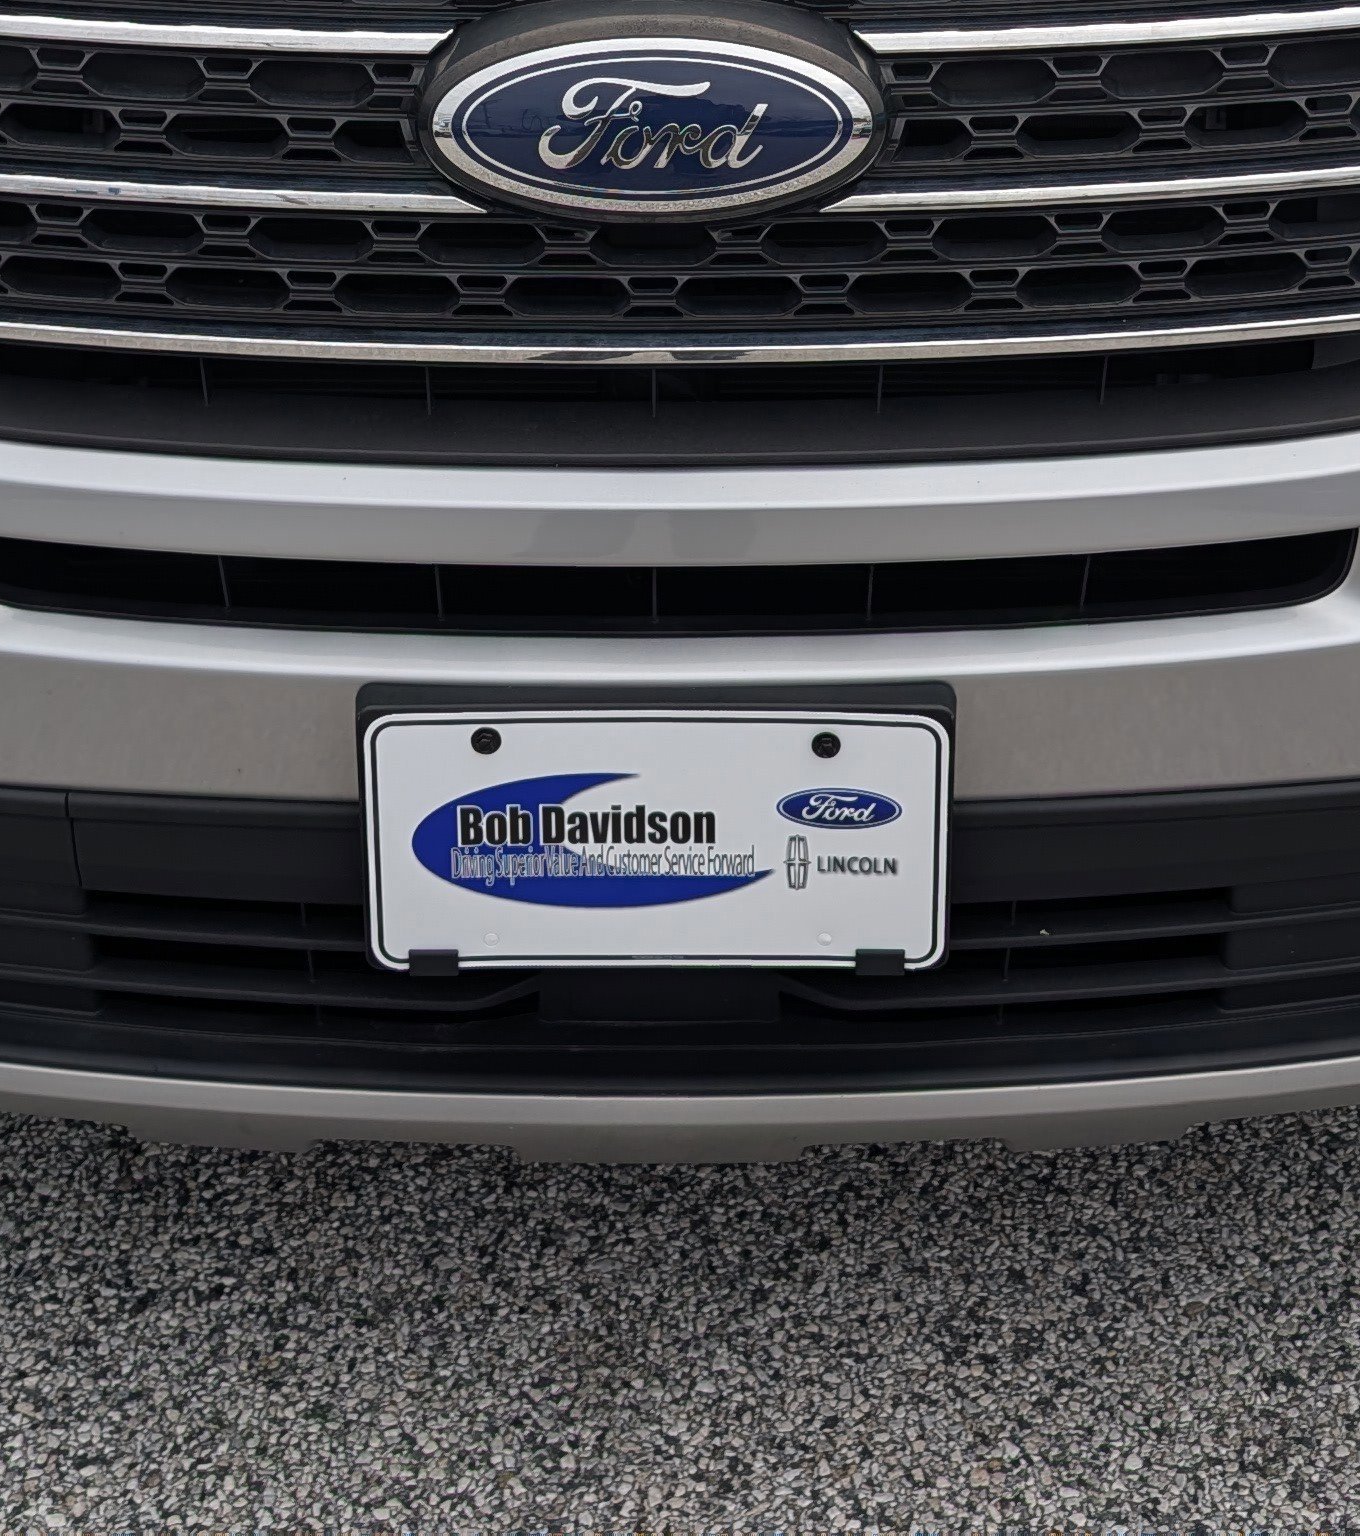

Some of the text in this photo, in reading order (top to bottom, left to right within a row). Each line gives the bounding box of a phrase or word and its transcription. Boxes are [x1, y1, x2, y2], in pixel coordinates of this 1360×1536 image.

[538, 76, 769, 170] Ford
[458, 803, 718, 847] Bob Davidson
[801, 793, 877, 822] Ford
[451, 845, 756, 886] Driving Superior Value And Customer Service Forward
[816, 856, 898, 875] LINCOLN
